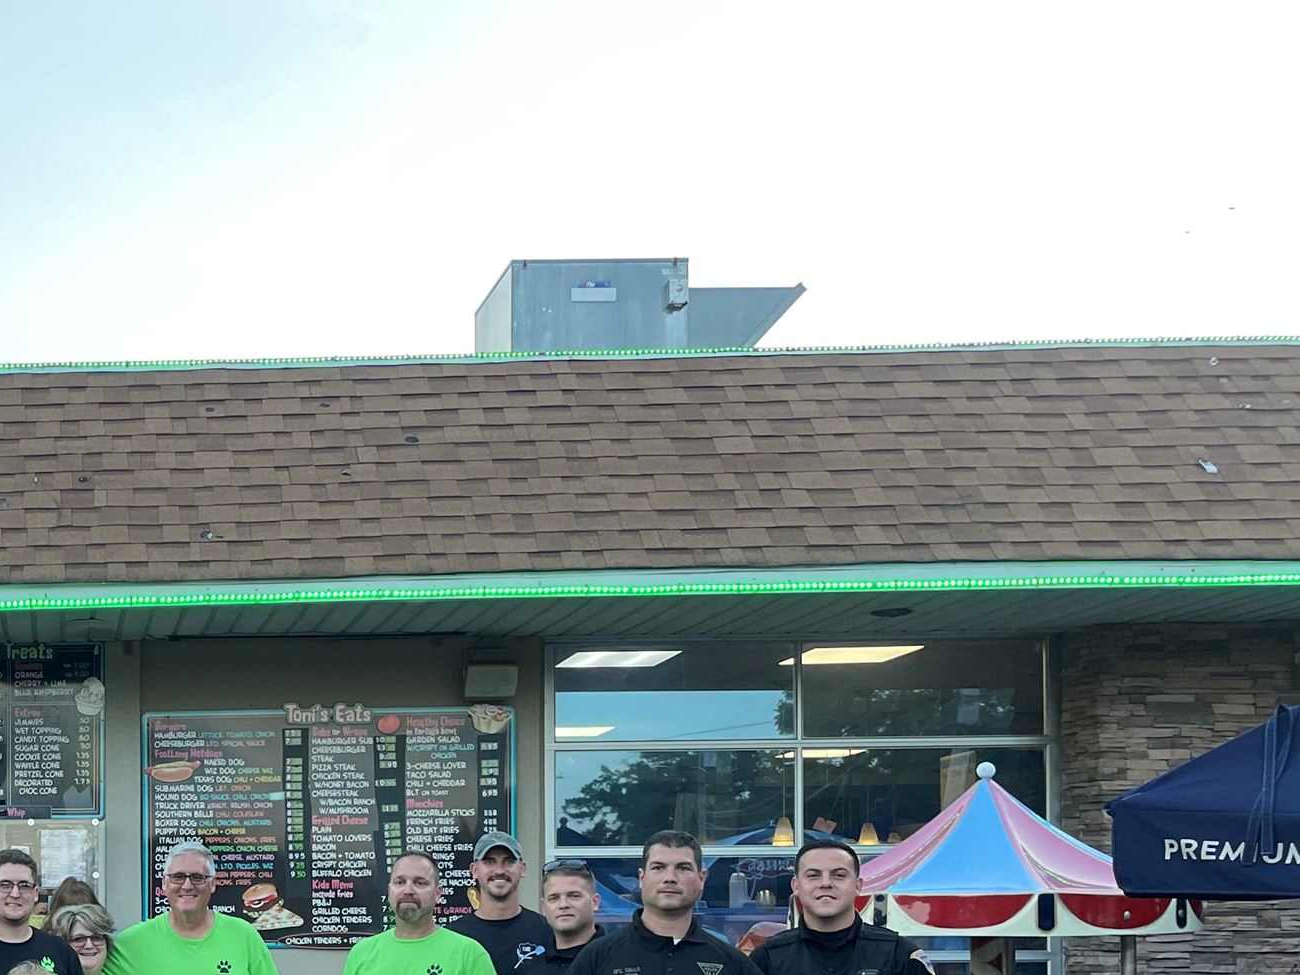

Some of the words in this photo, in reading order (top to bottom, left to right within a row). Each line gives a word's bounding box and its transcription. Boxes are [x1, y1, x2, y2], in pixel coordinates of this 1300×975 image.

[6, 643, 54, 660] Treats
[286, 703, 329, 723] Toni's
[335, 704, 371, 722] Eats
[7, 808, 25, 818] Whip
[155, 828, 178, 836] PUPPY
[312, 852, 336, 860] BACON
[312, 880, 330, 889] Kids
[331, 880, 353, 889] Menu
[312, 907, 340, 915] GRILLED
[342, 907, 367, 915] CHEESE
